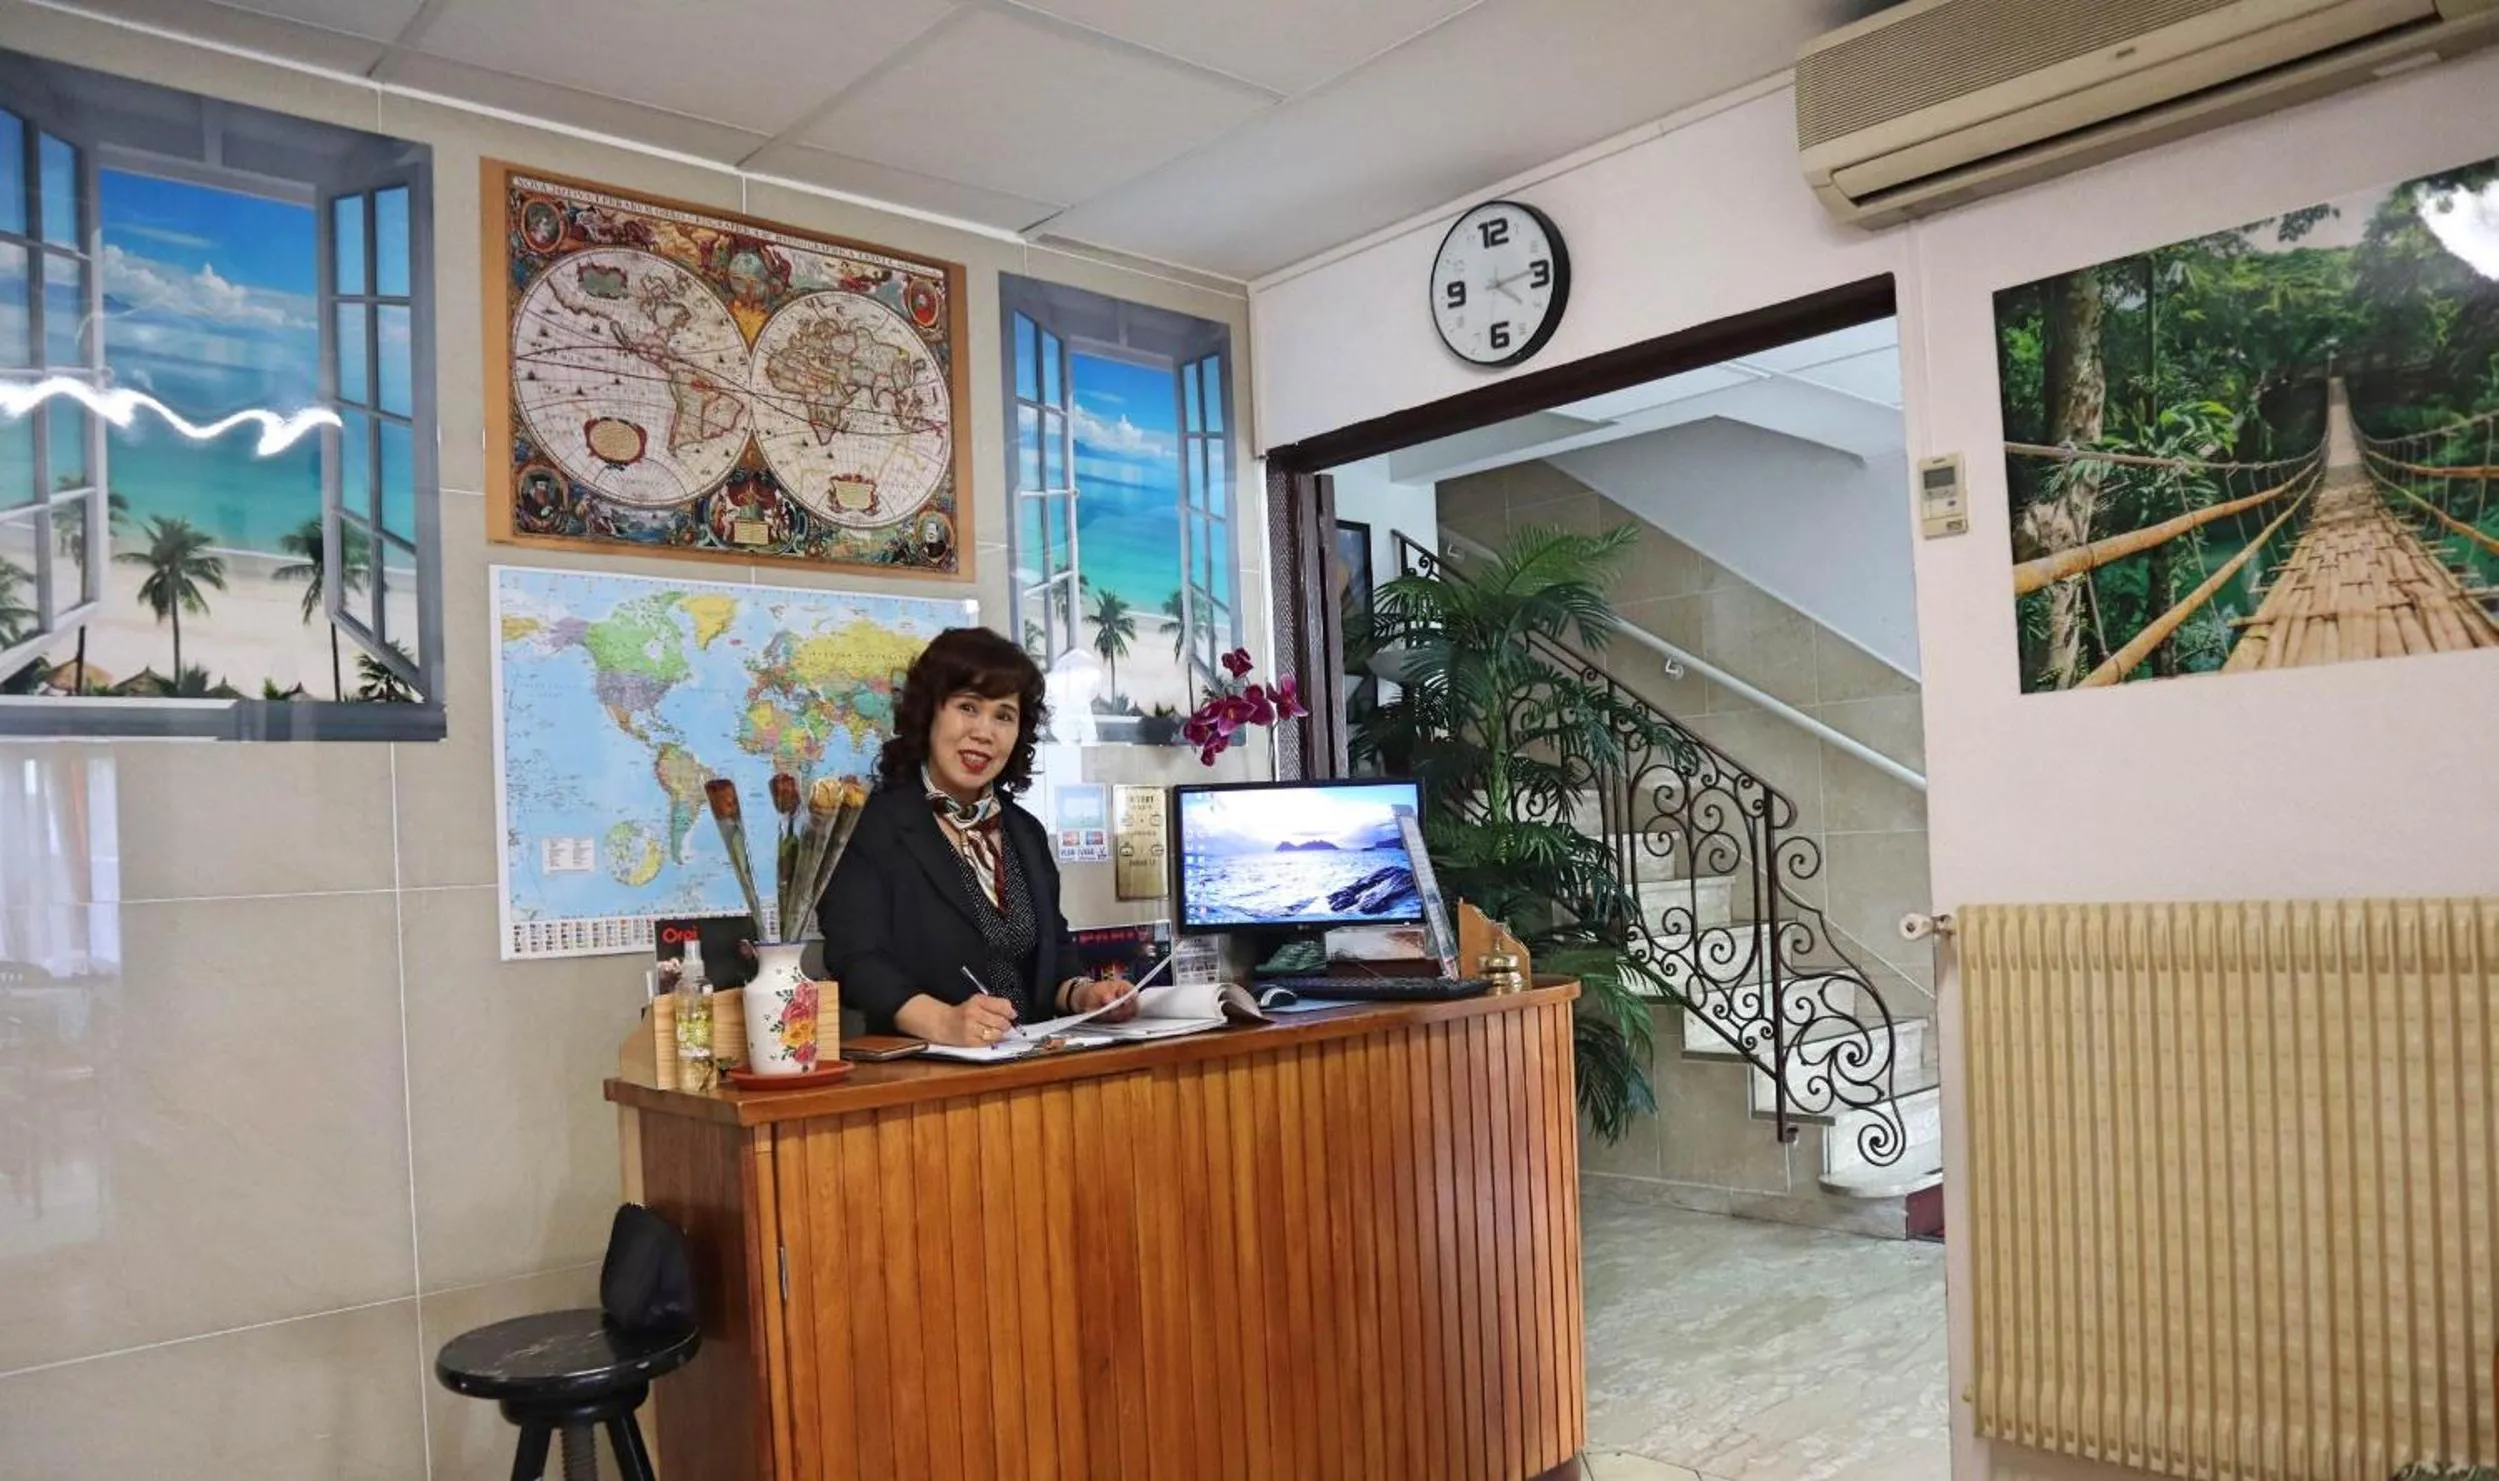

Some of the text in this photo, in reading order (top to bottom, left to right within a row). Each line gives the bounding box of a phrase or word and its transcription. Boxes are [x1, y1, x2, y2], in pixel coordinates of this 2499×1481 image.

[1478, 217, 1509, 249] 12
[1529, 260, 1550, 289] 3
[1447, 281, 1466, 309] 9
[1490, 321, 1510, 349] 6
